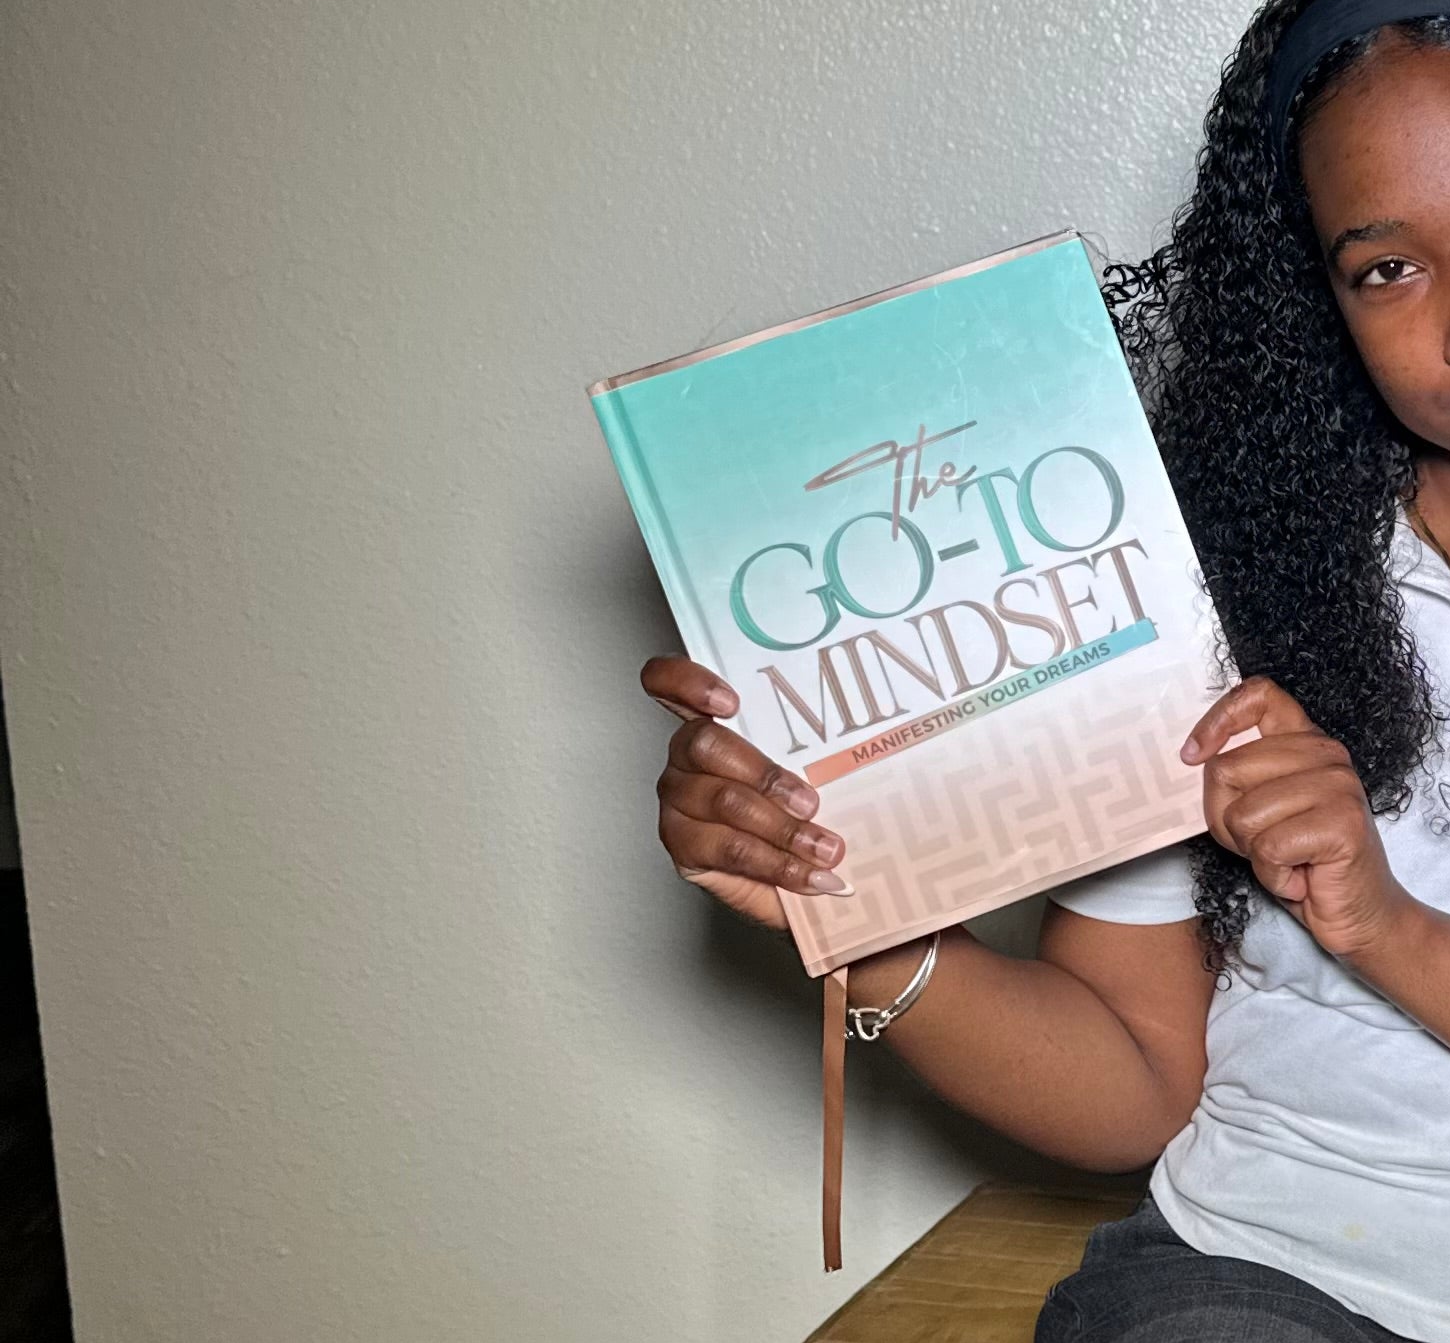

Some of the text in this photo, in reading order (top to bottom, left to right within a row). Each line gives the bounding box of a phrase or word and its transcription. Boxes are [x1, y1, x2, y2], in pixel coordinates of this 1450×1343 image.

[729, 446, 1125, 651] GO-TO
[804, 420, 978, 542] The
[757, 538, 1158, 754] MINDSET
[852, 642, 1111, 763] MANIFESTING YOUR DREAMS
